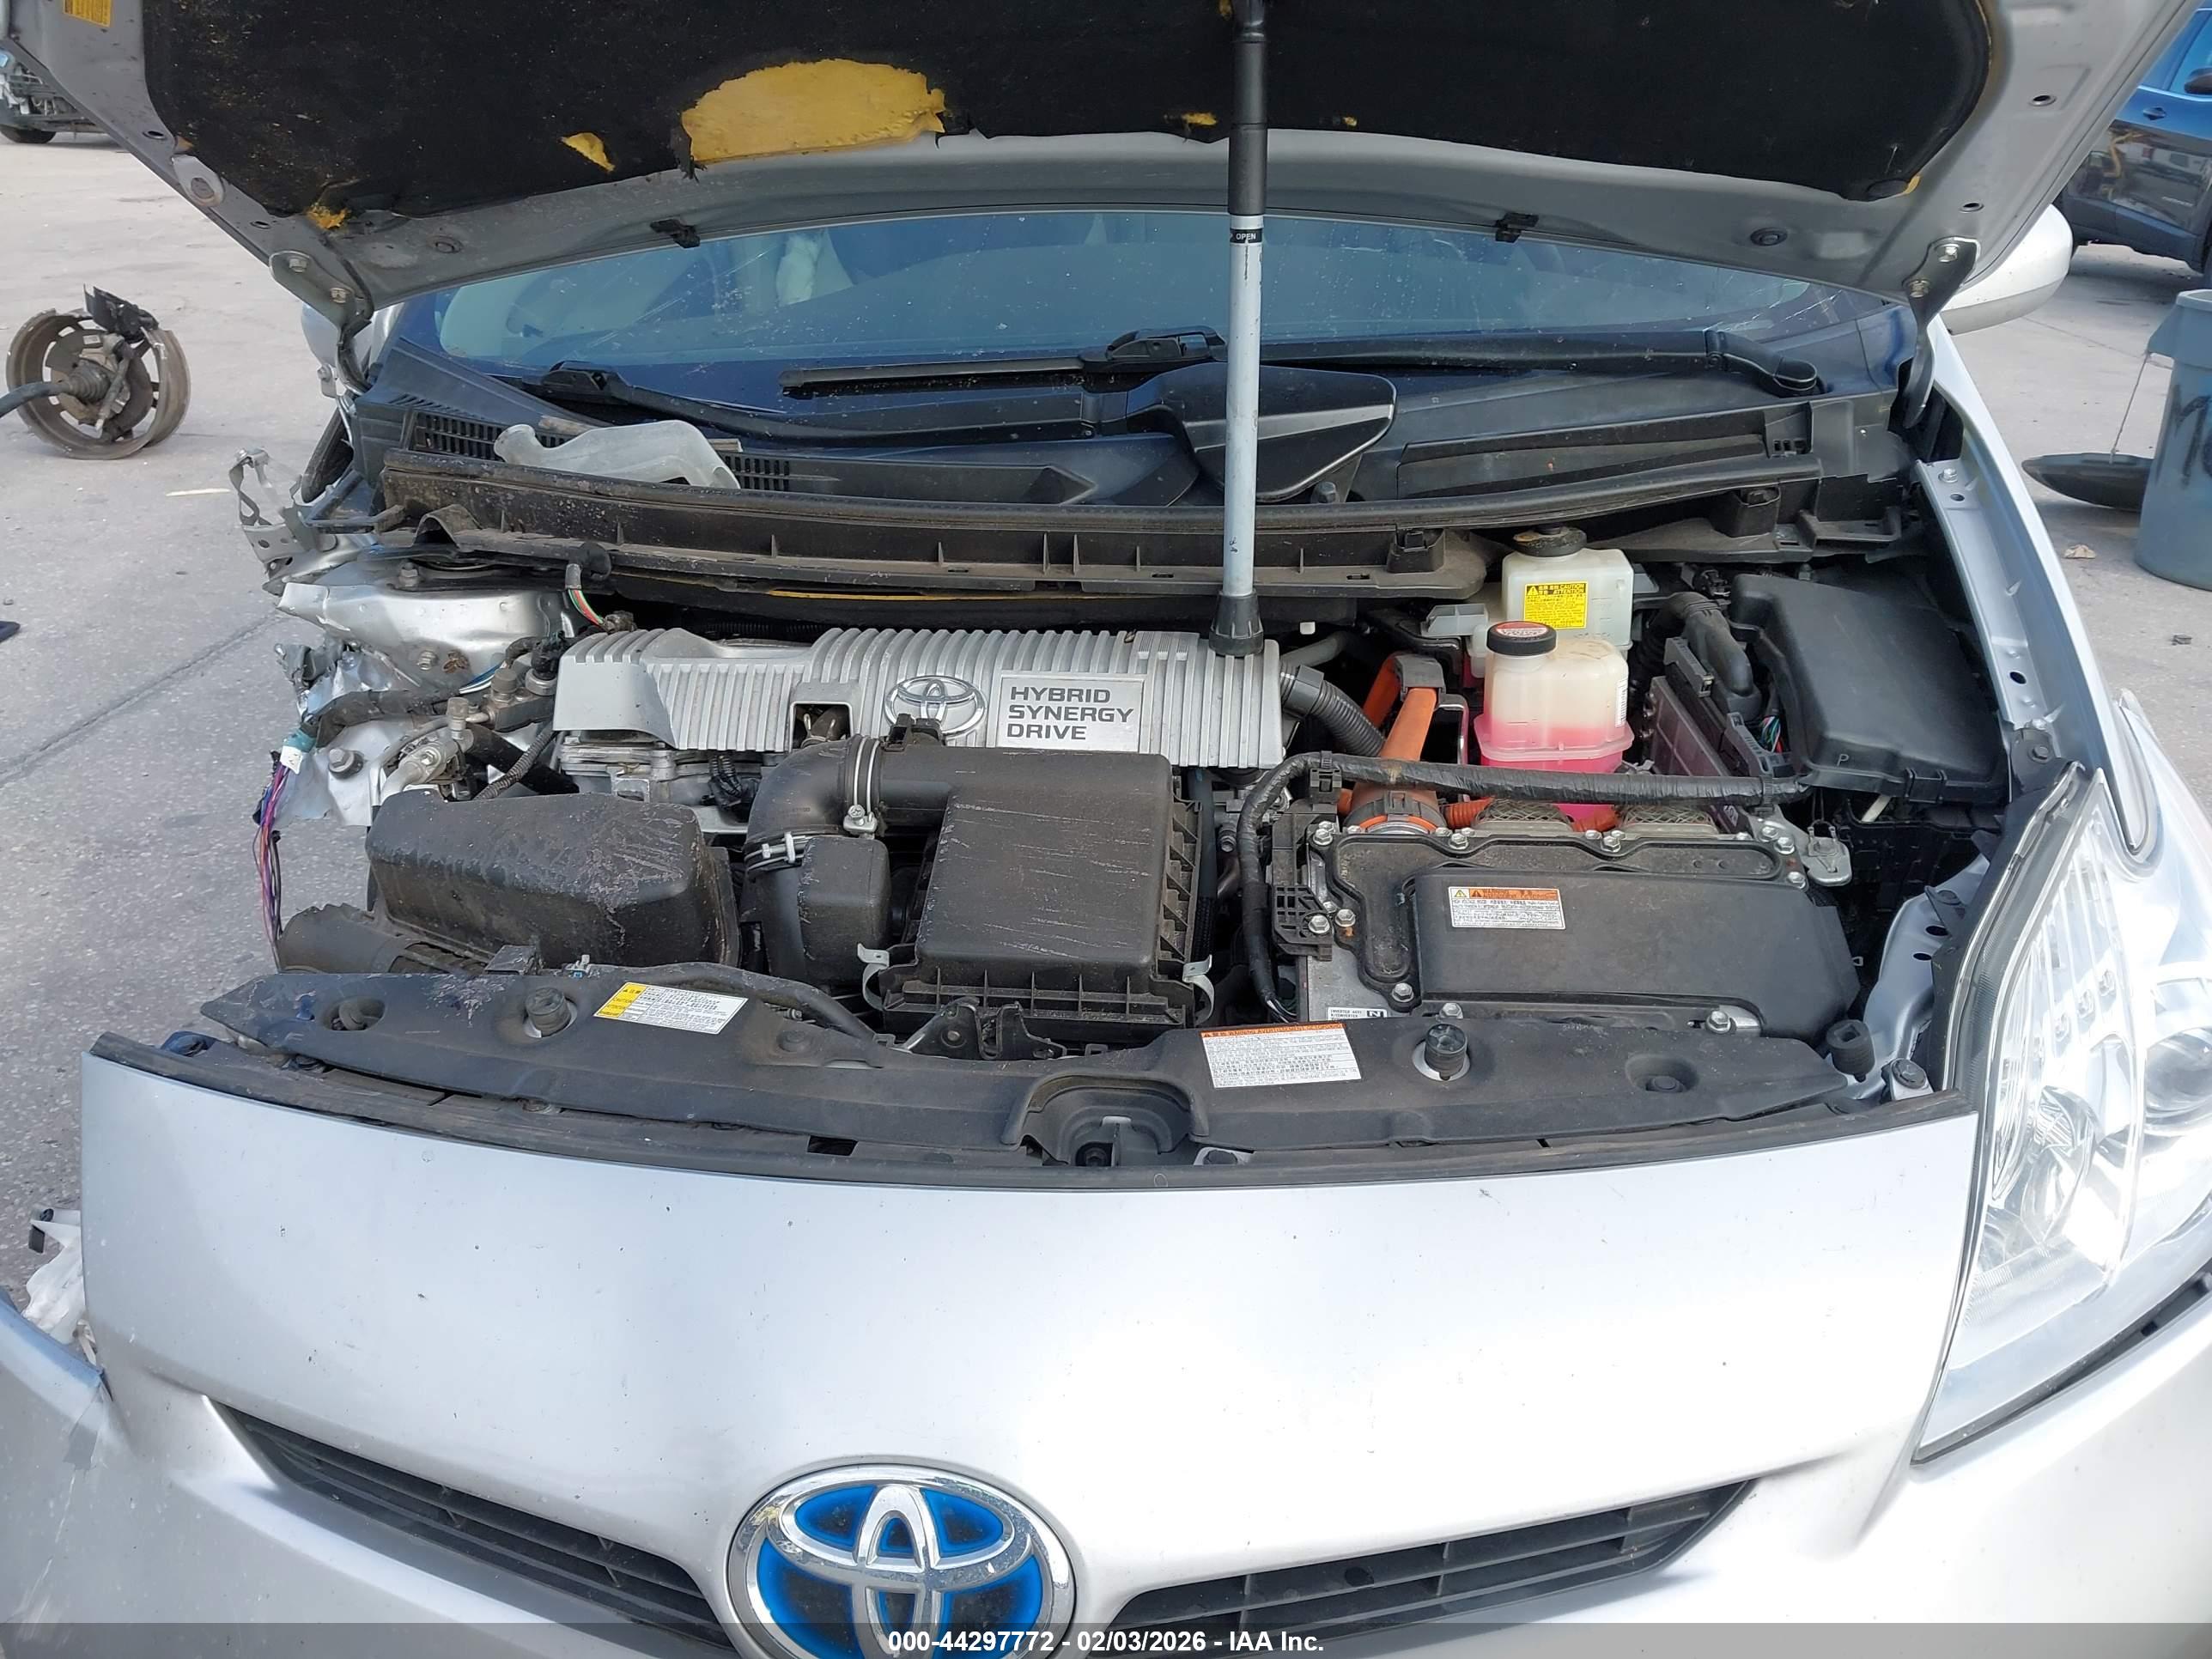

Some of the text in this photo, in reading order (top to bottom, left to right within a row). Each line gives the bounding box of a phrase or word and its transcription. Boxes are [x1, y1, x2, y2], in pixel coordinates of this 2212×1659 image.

[1010, 686, 1111, 703] HYBRID
[1008, 704, 1134, 723] SYNERGY
[1006, 723, 1087, 740] DRIVE
